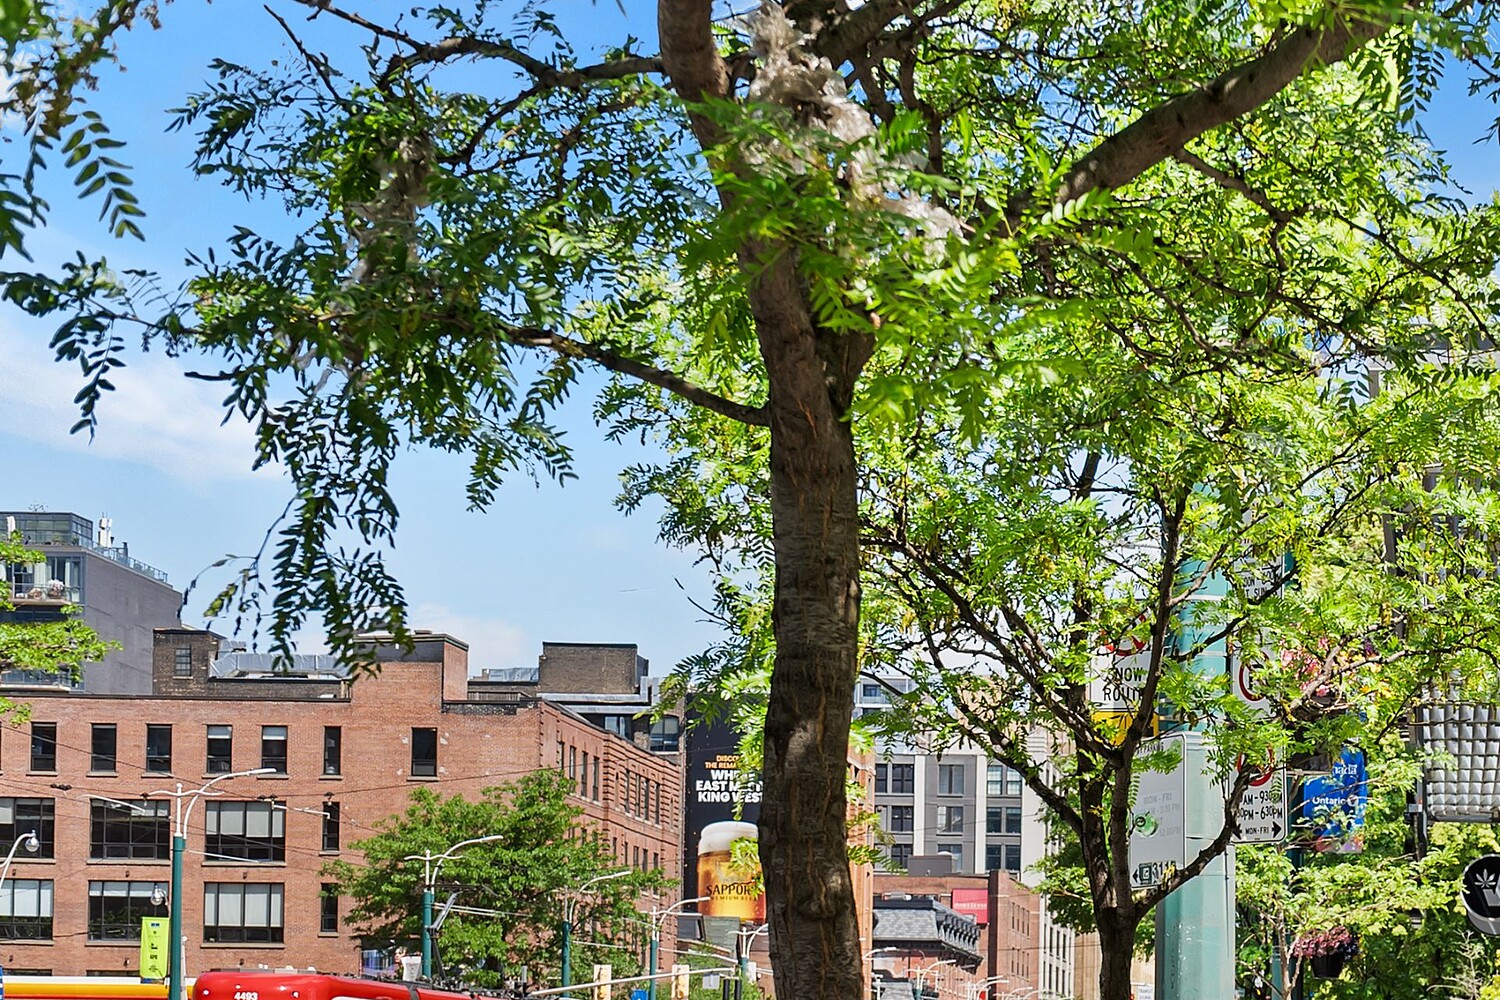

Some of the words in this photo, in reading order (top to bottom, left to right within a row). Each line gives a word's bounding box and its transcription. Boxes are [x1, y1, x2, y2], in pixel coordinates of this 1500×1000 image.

[1103, 687, 1141, 701] ROUT
[696, 780, 728, 791] EAST
[698, 792, 730, 802] KING
[706, 882, 752, 896] SAPPOR
[234, 992, 258, 1000] 4493
